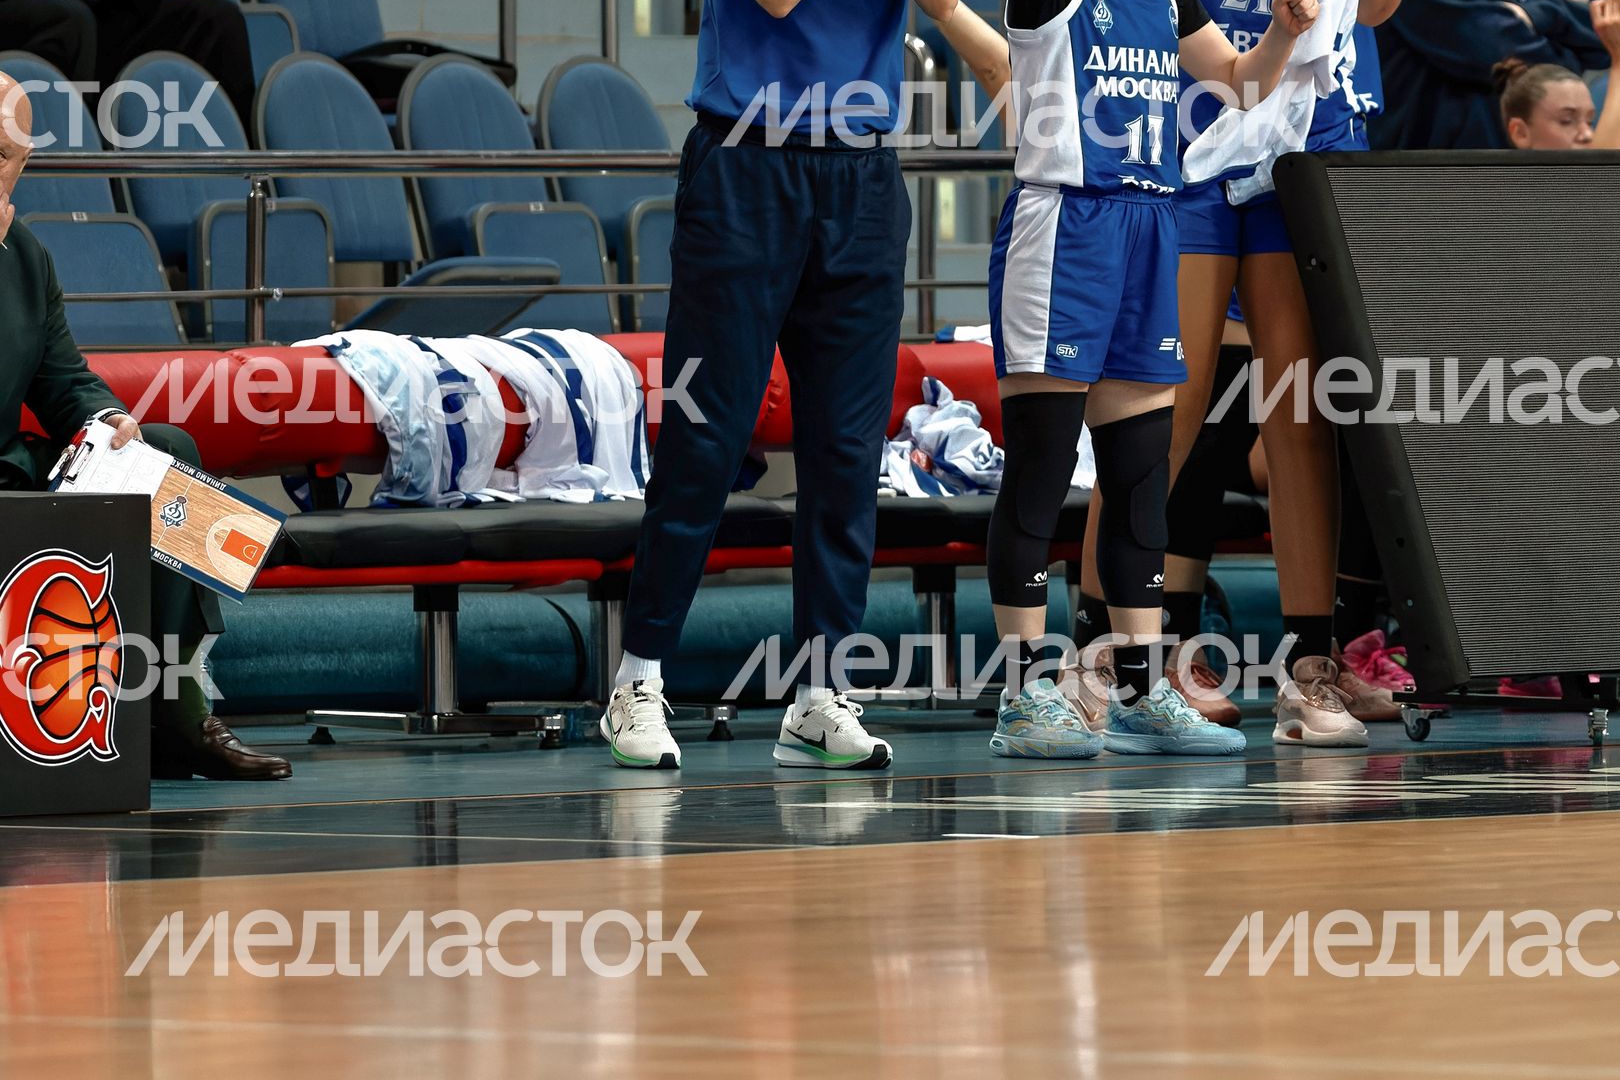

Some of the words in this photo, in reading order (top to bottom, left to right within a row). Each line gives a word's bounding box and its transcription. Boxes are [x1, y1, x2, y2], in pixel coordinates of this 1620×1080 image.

[1083, 45, 1179, 79] ДИНАМ
[1094, 75, 1178, 104] МОСКВА
[171, 459, 196, 476] МОСКВ
[195, 471, 227, 491] ДИНАМО
[153, 550, 183, 570] МОСКВА
